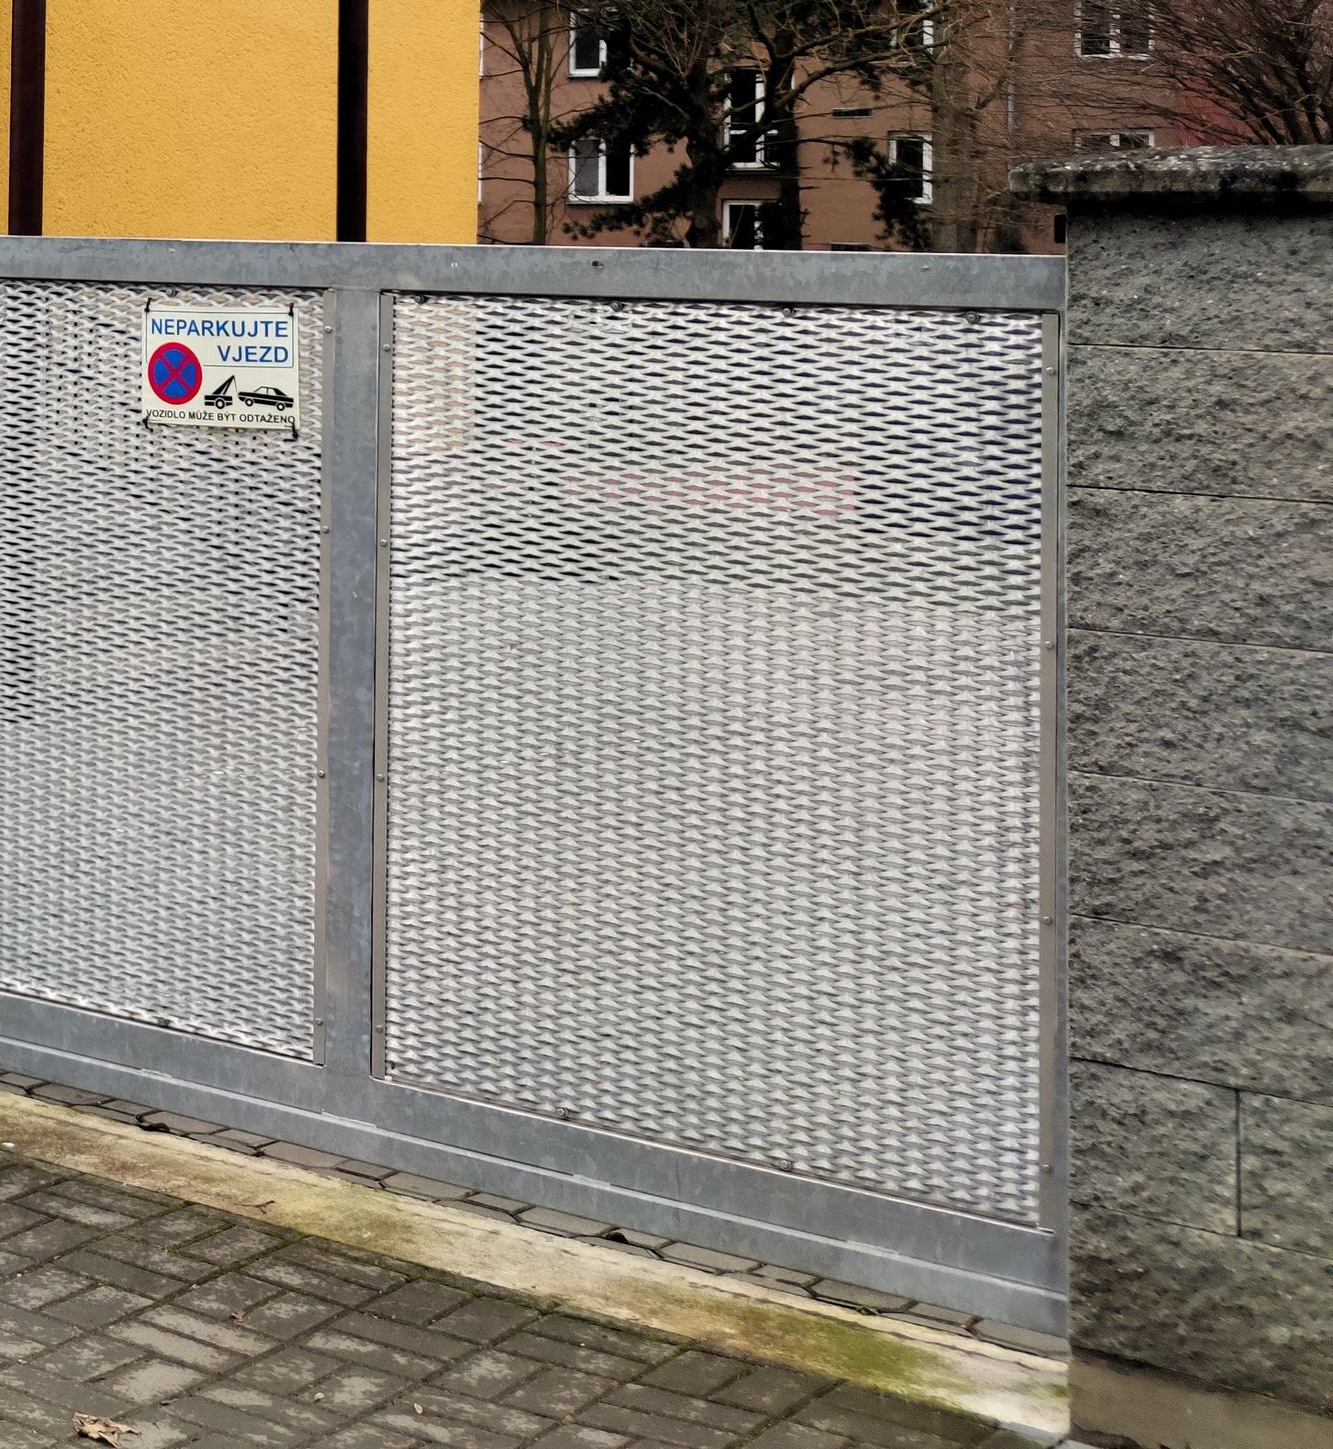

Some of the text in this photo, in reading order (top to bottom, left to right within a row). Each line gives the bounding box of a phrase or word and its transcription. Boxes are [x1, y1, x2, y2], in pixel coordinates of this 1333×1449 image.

[151, 318, 289, 338] NEPARKUJTE
[217, 345, 289, 363] VJEZD
[147, 409, 295, 424] VOZIDLO MŮŽE BÝT ODTAŽENO
